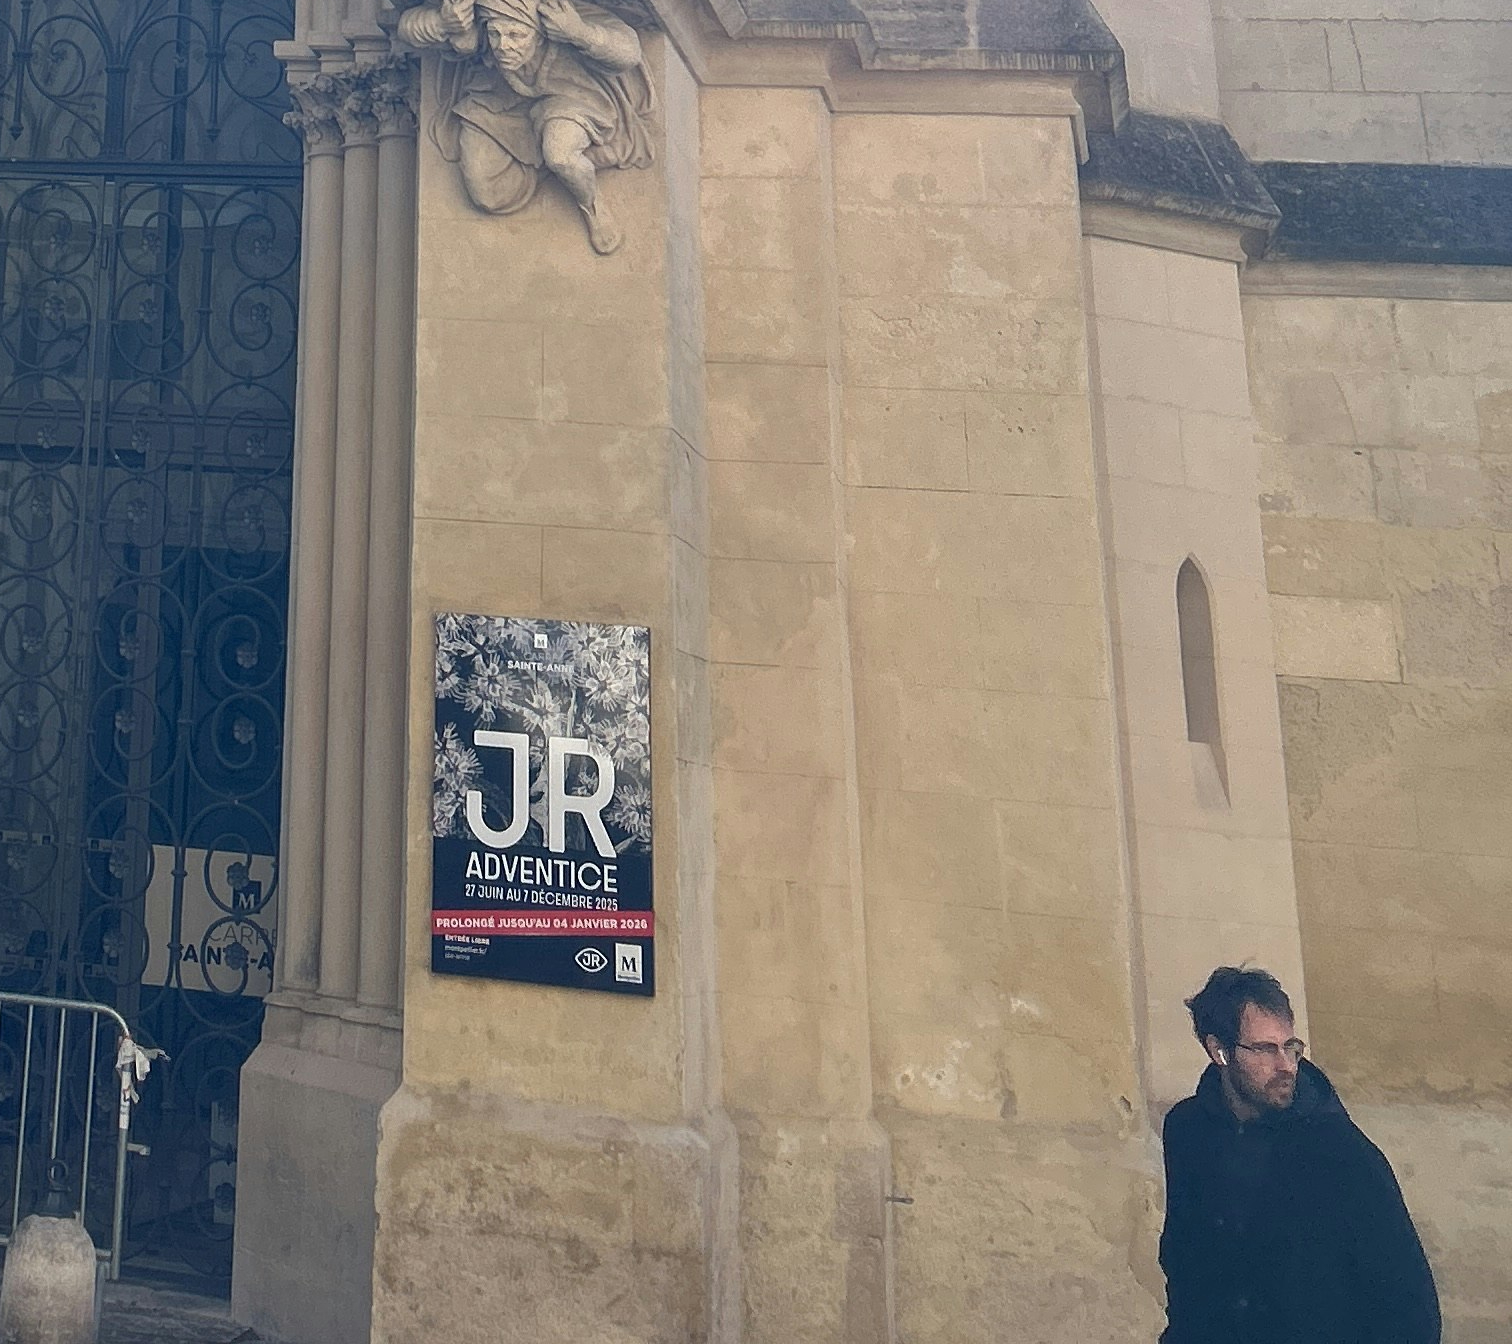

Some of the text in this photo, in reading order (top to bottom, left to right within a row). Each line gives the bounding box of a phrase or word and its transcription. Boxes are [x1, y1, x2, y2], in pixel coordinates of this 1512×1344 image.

[466, 729, 617, 859] JR
[465, 850, 619, 894] ADVENTICE
[238, 892, 255, 910] M
[464, 883, 619, 912] 27 JUIN AU 7 DÉCEMBRE 2025
[436, 916, 496, 929] PROLONGÉ
[497, 917, 551, 929] JUSQU'AU
[553, 917, 568, 929] 04
[570, 917, 619, 930] JANVIER
[582, 952, 601, 969] JR
[621, 955, 637, 973] M
